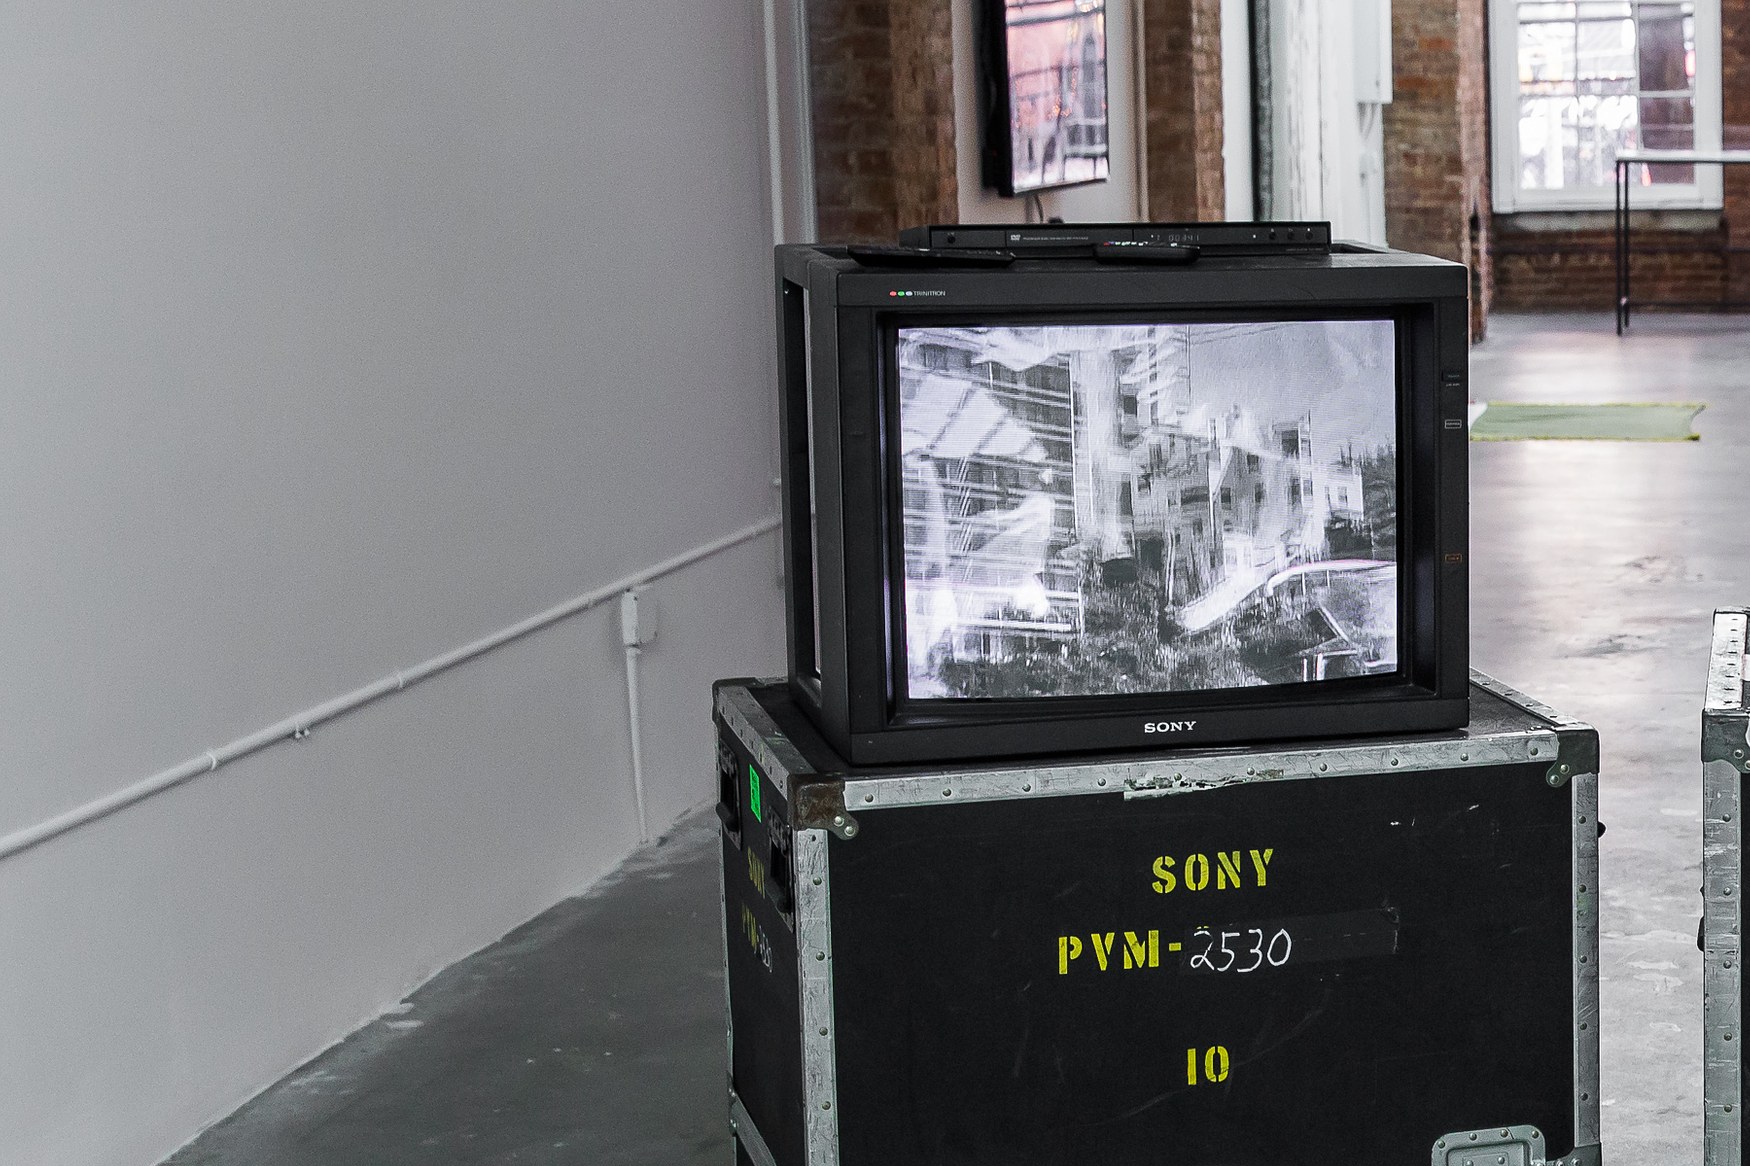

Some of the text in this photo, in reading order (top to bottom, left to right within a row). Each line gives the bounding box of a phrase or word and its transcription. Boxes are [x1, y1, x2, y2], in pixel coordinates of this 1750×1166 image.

[1143, 720, 1197, 734] SONY
[1151, 848, 1274, 894] SONY
[1187, 1045, 1230, 1086] 10
